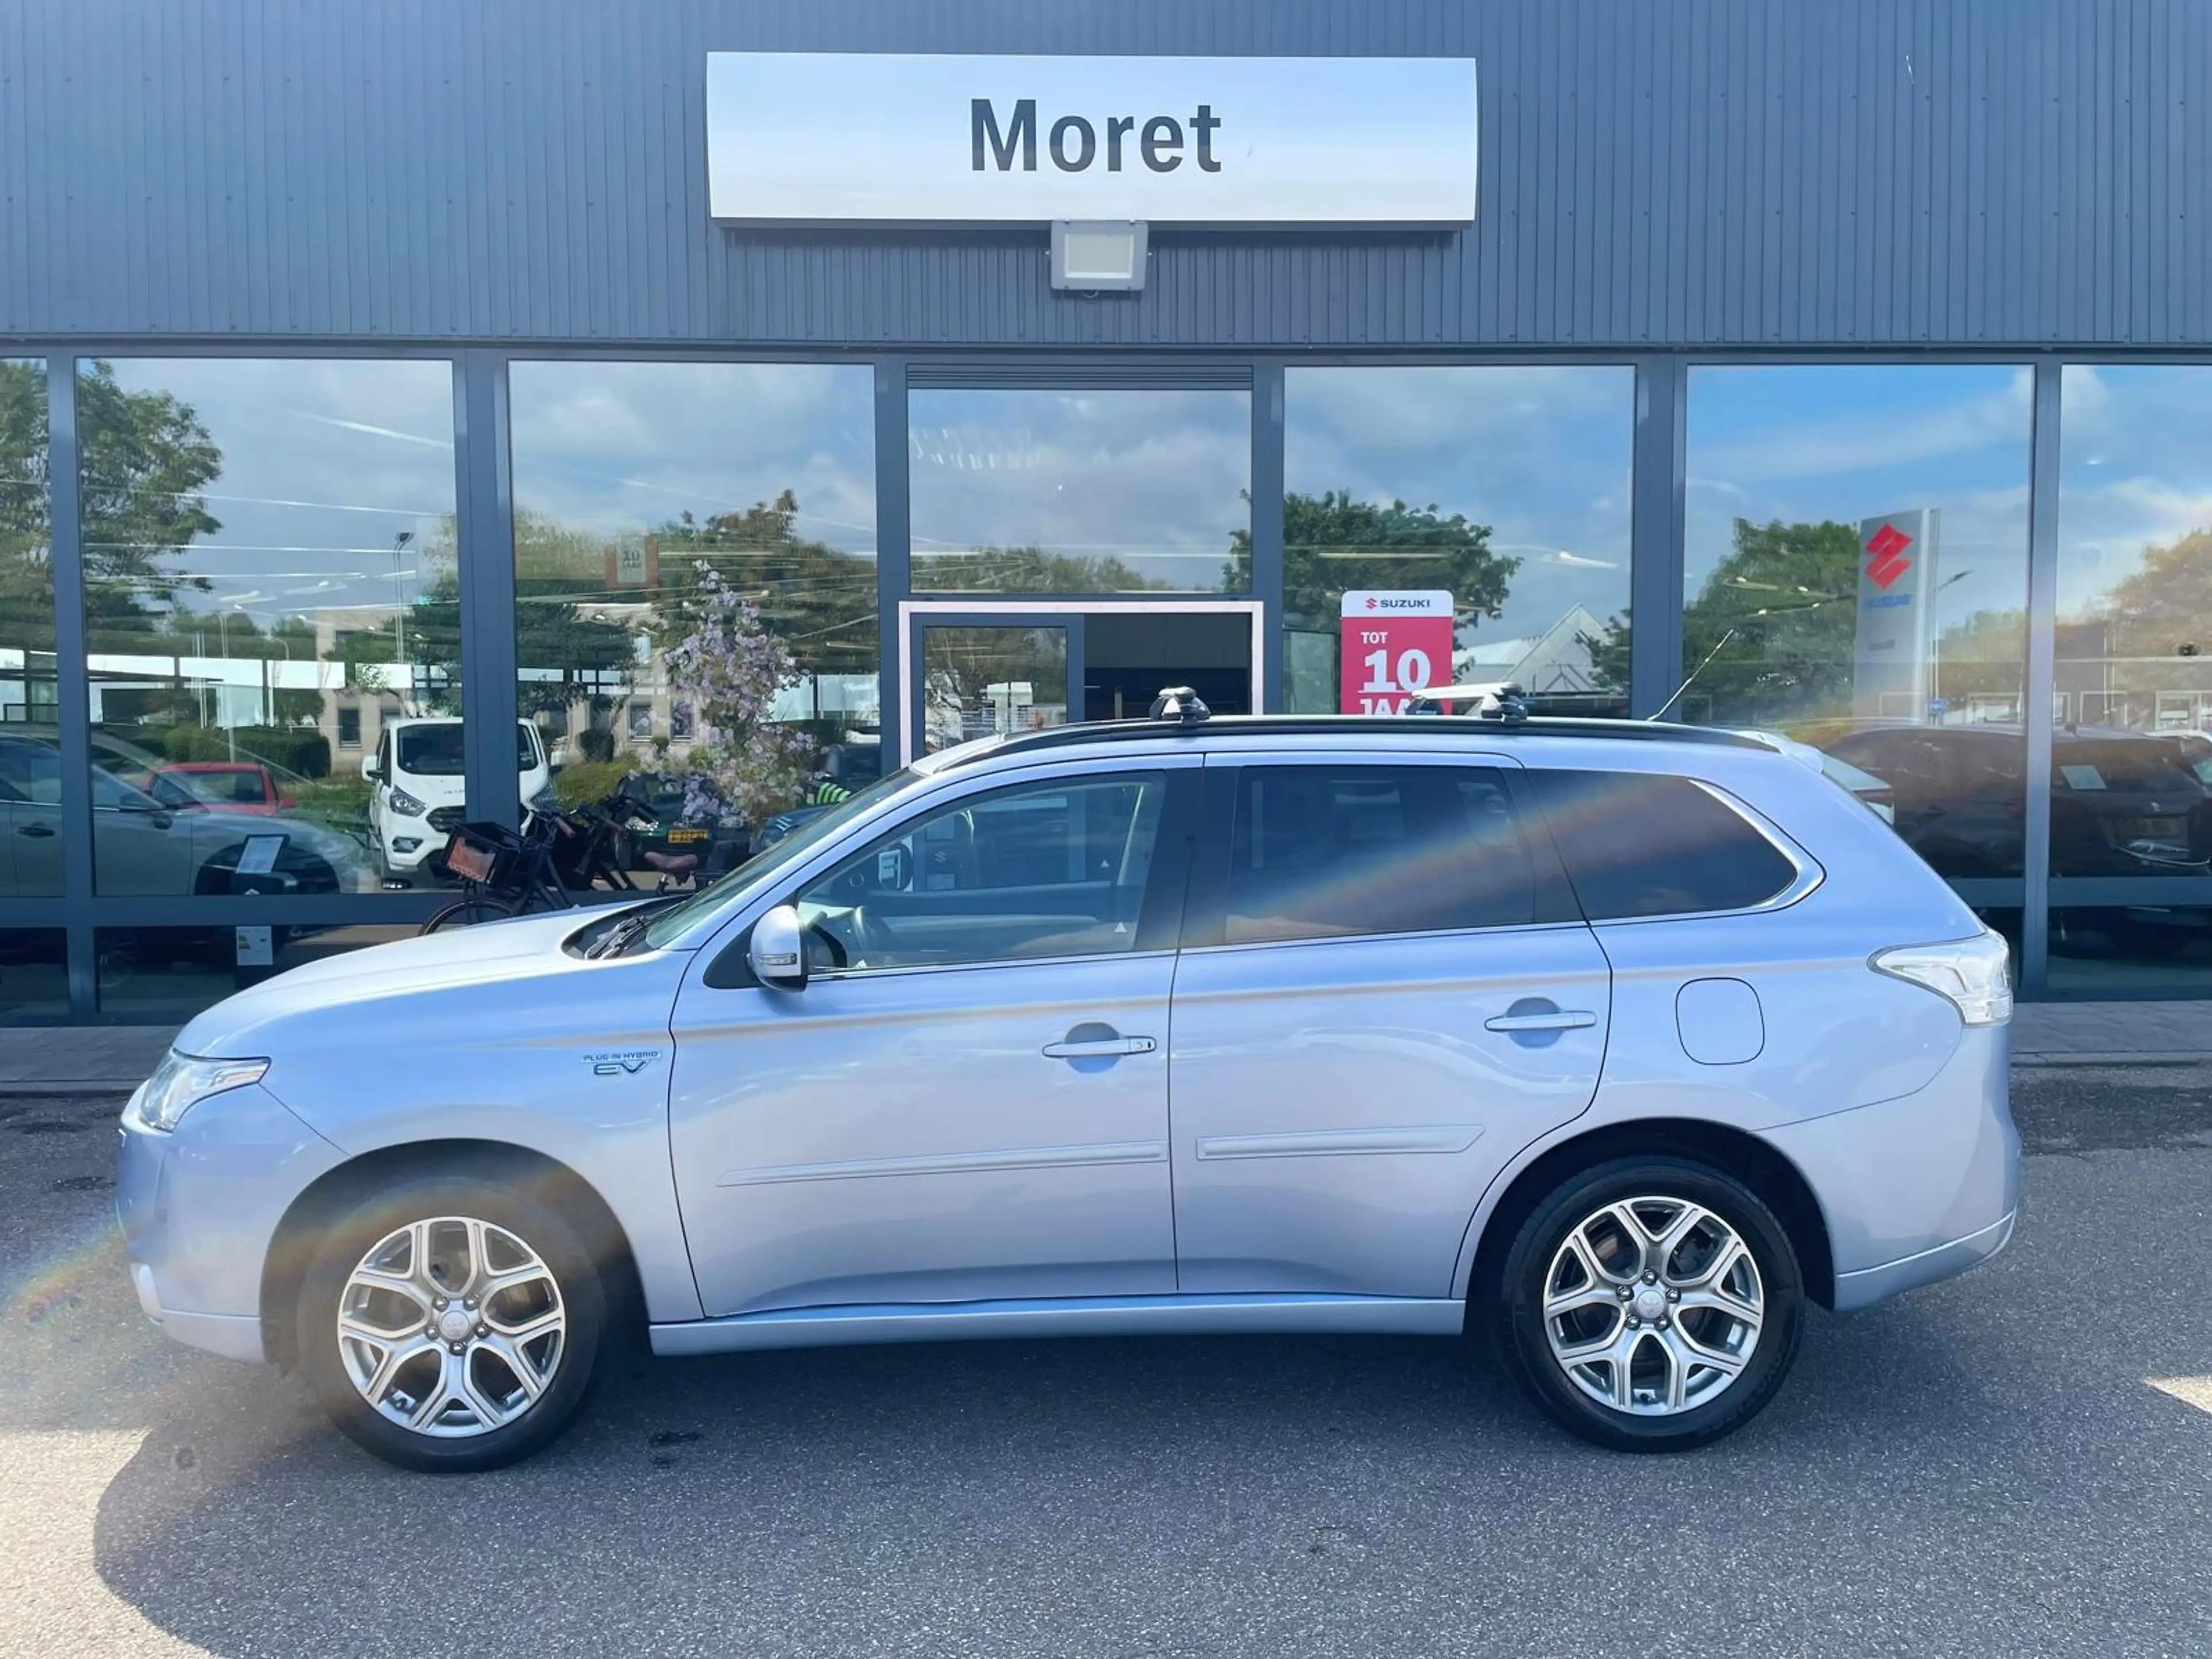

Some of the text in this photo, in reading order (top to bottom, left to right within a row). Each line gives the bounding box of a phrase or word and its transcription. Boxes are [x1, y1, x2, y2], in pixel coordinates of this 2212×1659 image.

[971, 99, 1221, 172] Moret
[1380, 599, 1430, 608] SUZUKI
[1361, 631, 1388, 644] TOT
[1363, 649, 1431, 692] 10
[623, 1051, 658, 1059] HYBRID
[594, 1061, 646, 1074] EV
